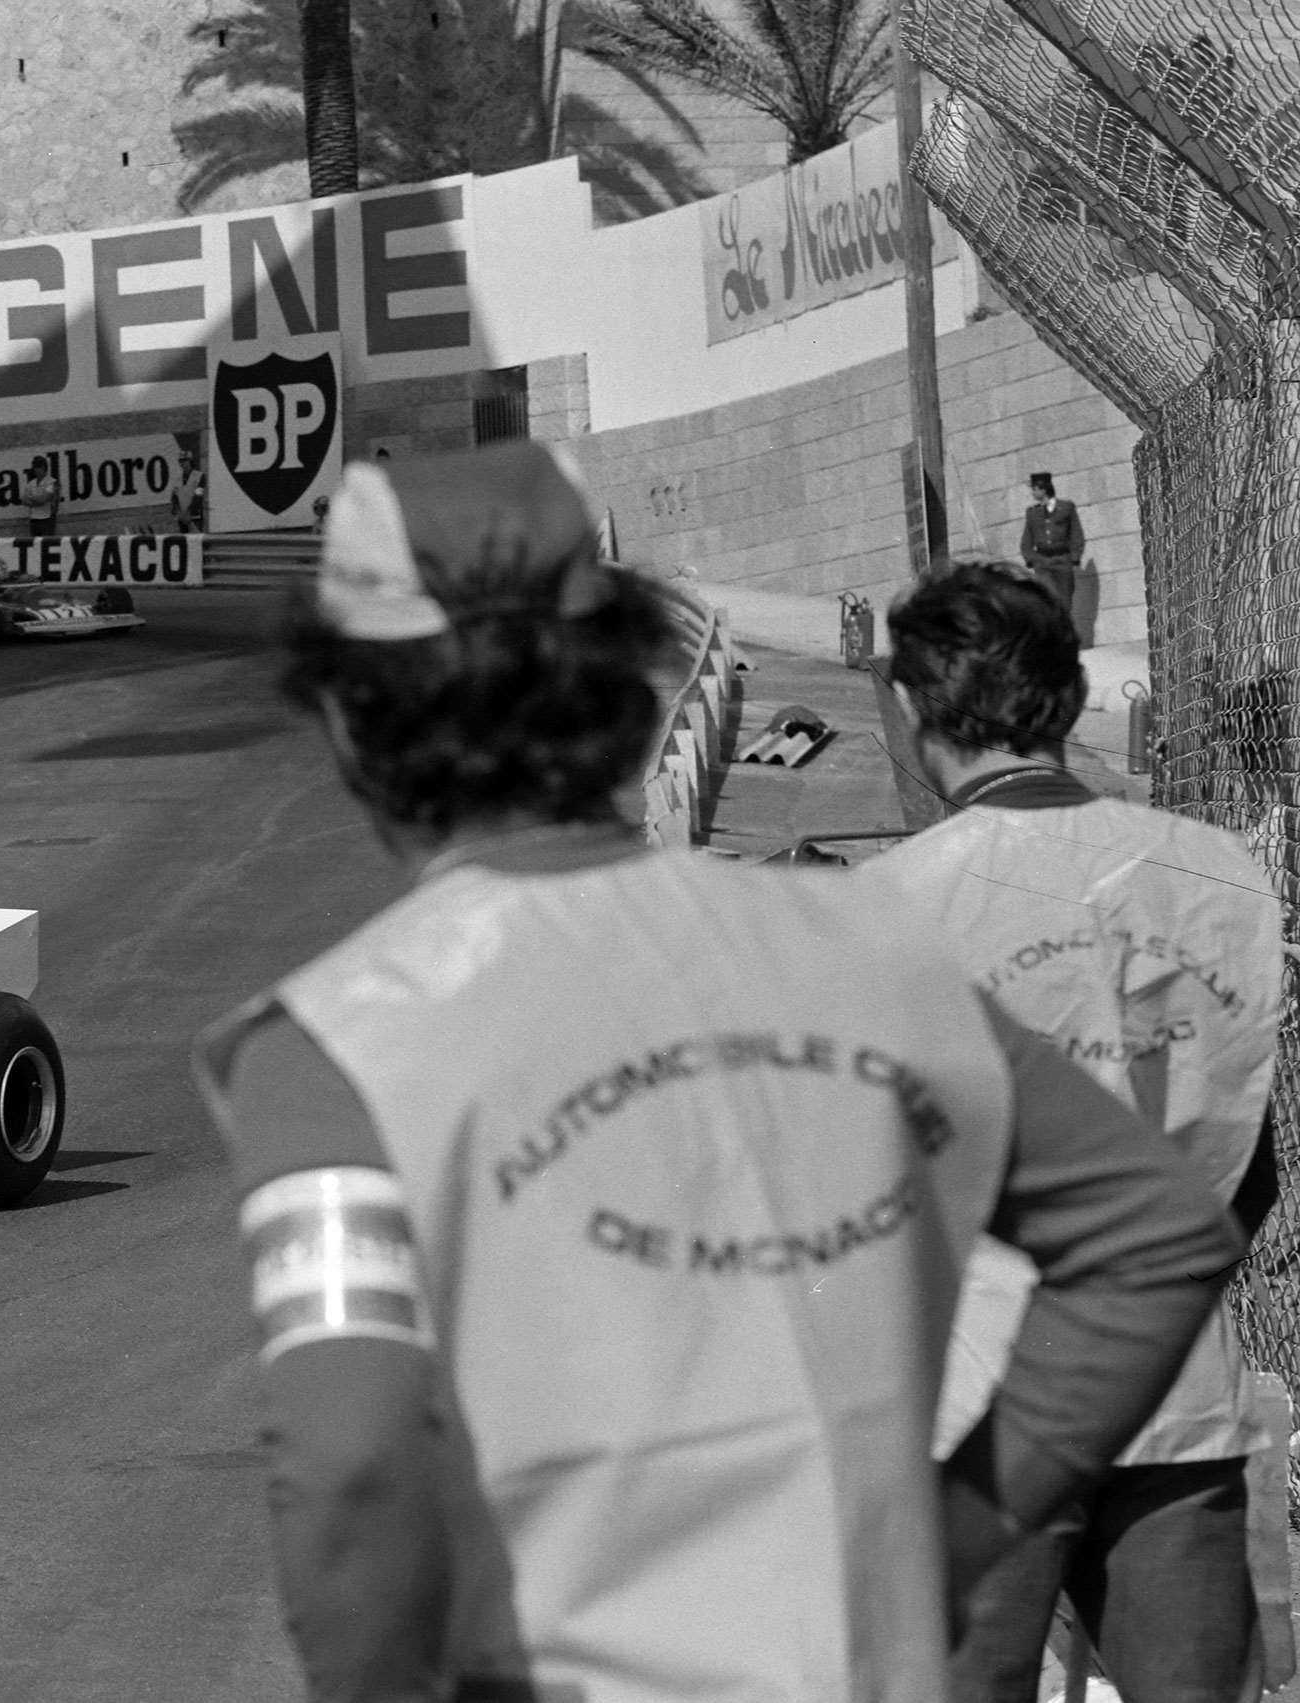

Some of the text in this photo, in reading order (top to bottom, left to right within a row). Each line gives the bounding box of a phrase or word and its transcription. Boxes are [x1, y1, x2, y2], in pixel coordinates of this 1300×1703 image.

[718, 145, 906, 320] Le Mirabea
[230, 382, 326, 473] BP
[12, 535, 188, 582] TEXACO
[587, 1206, 672, 1268] DE
